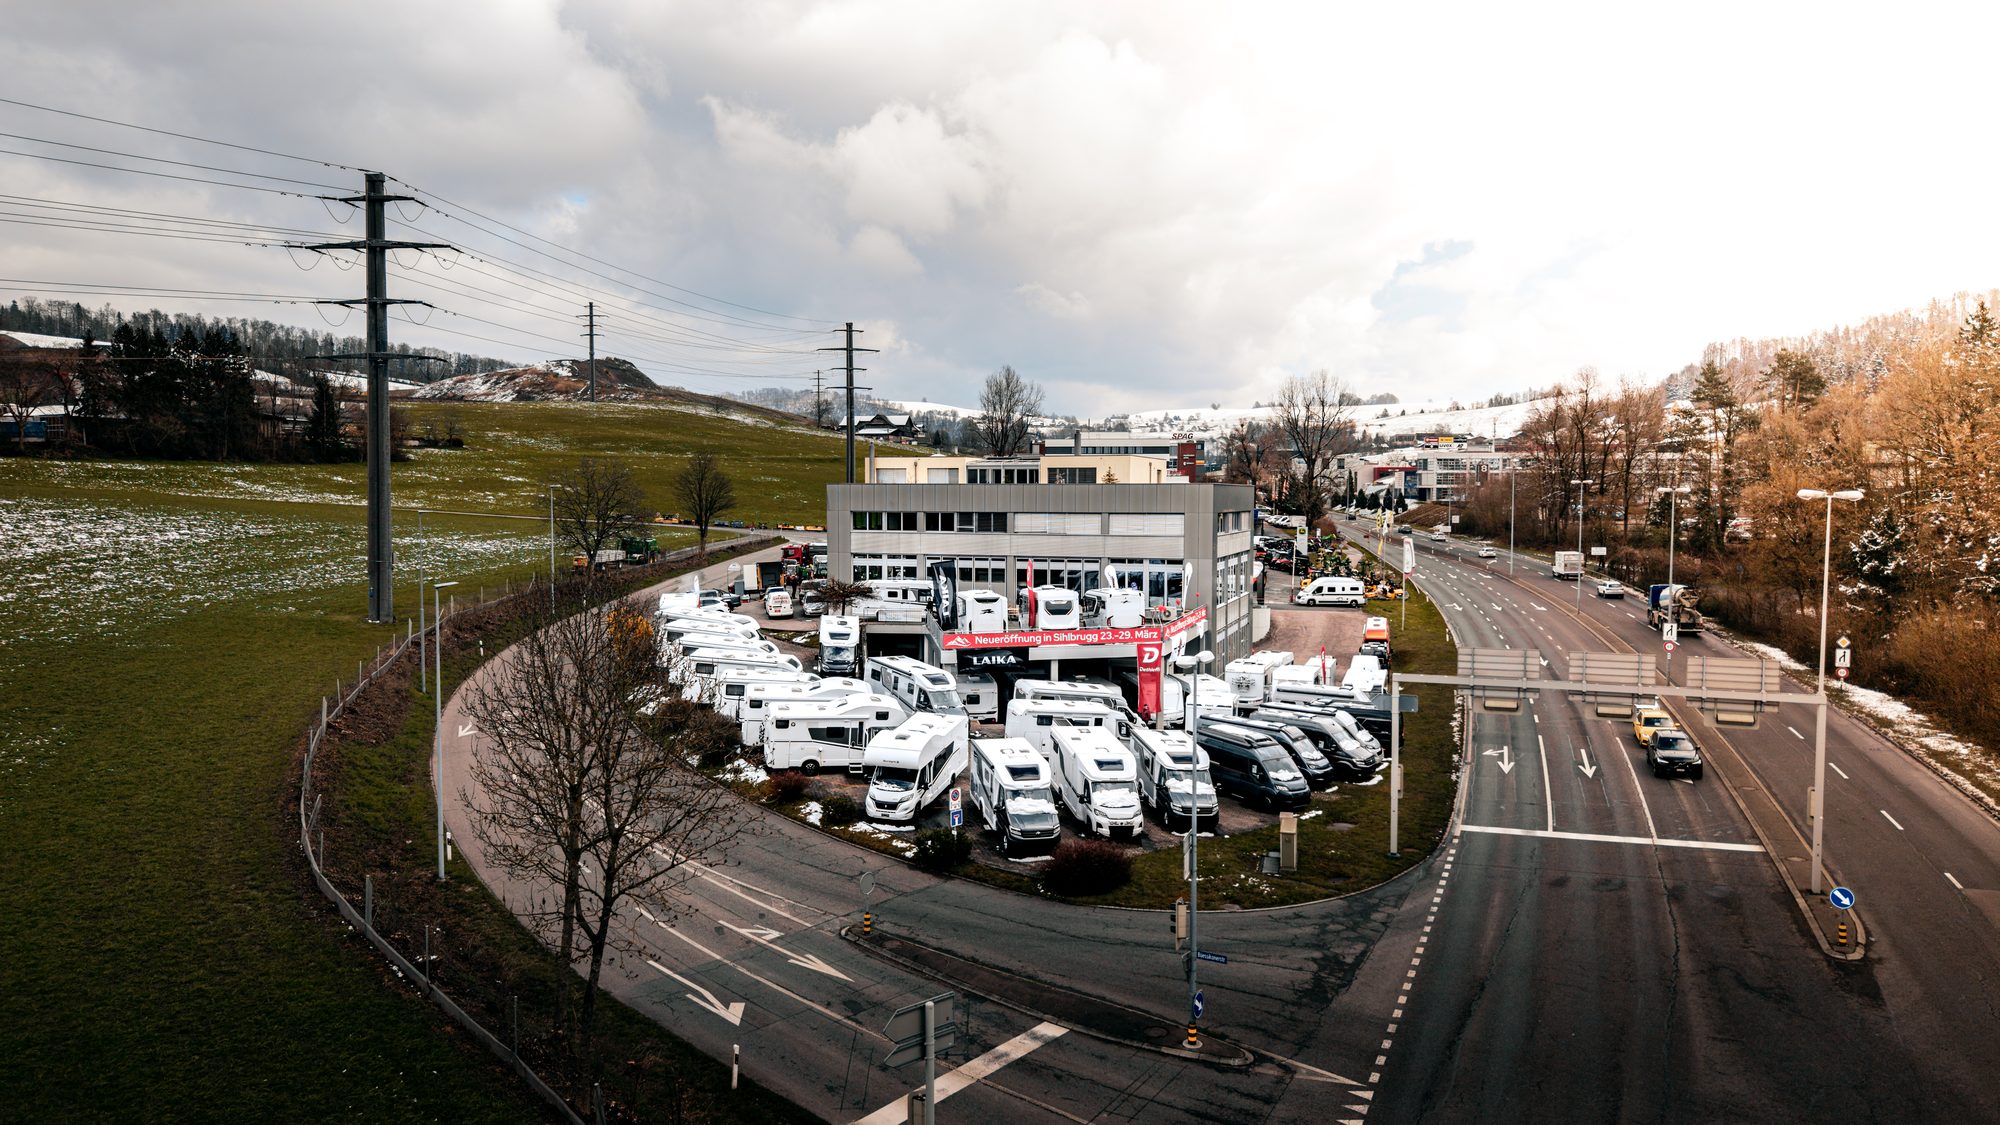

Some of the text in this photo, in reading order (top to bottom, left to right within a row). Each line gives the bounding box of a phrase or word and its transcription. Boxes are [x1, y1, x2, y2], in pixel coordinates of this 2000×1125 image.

[939, 575, 950, 617] LAIKA
[975, 633, 1042, 645] Neueröffnung
[1043, 633, 1052, 642] in
[1053, 632, 1098, 643] Sihlbrugg
[1135, 630, 1158, 639] März
[973, 655, 1017, 665] LAIKA
